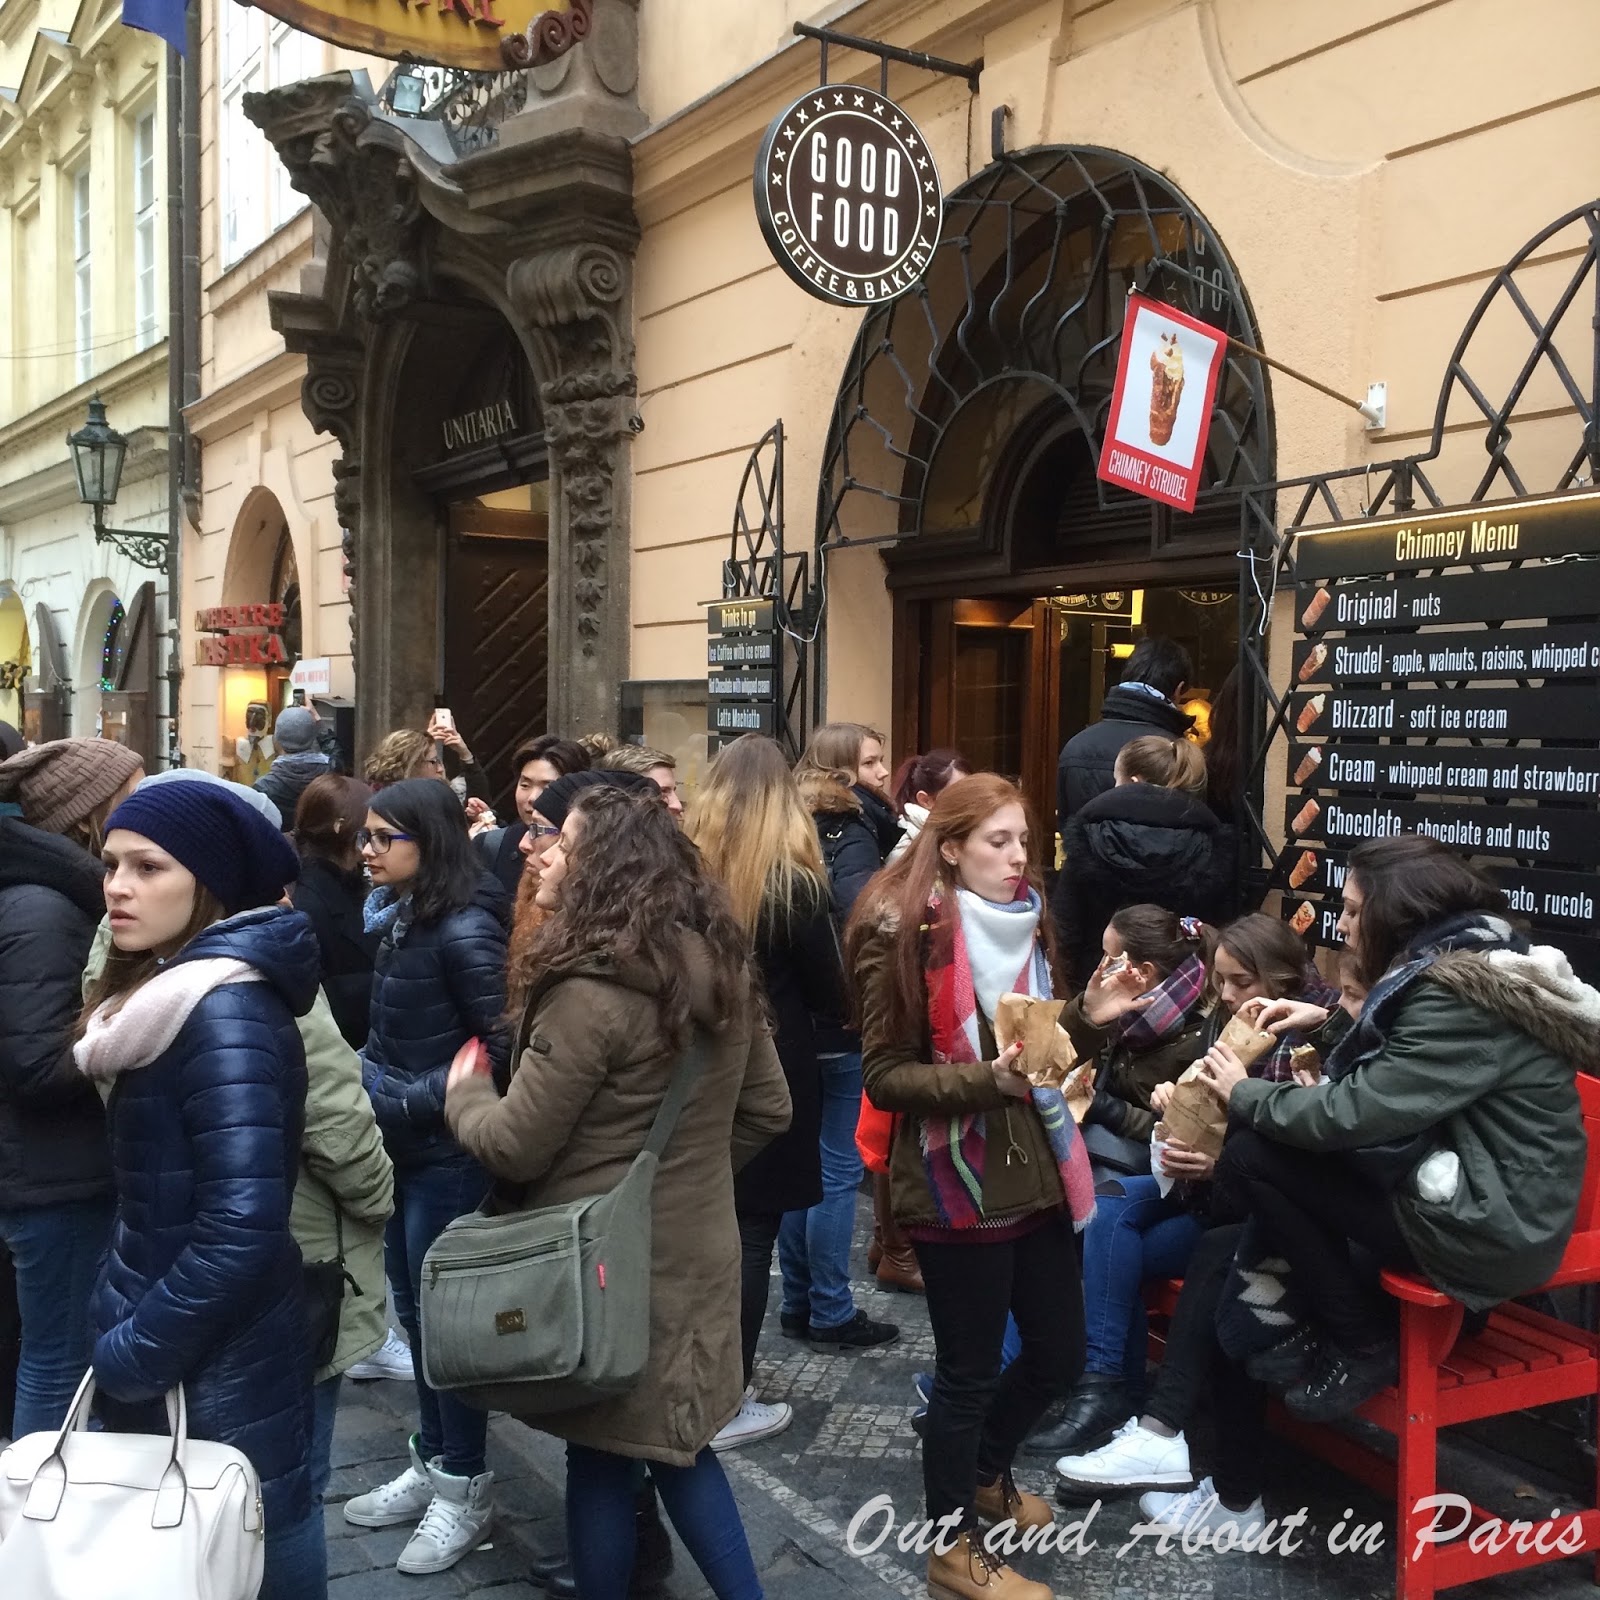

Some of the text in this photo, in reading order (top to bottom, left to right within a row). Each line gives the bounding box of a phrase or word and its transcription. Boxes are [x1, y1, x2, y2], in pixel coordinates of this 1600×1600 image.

[810, 131, 901, 198] GOOD
[810, 191, 899, 257] FOOD
[774, 210, 840, 293] COFFEE
[864, 235, 933, 299] BAKERY
[443, 399, 517, 450] UNITARIA
[1108, 449, 1188, 502] CHIMNEY STRUDEL
[1395, 520, 1519, 561] Chimney Menu
[721, 608, 756, 629] Drinks to go
[1337, 589, 1398, 625] Original
[1412, 592, 1441, 617] nuts
[716, 643, 733, 662] Coffee
[1335, 643, 1383, 675] Strudel
[1392, 648, 1425, 676] apple,
[1428, 646, 1478, 672] walnuts,
[1481, 644, 1527, 671] raisins,
[1531, 641, 1588, 672] whipped
[717, 707, 732, 727] Latte
[1332, 699, 1394, 729] Blizzard
[1410, 704, 1436, 729] soft
[1440, 704, 1461, 729] ice
[1465, 708, 1508, 729] cream
[1329, 752, 1376, 783] Cream
[1388, 760, 1443, 789] whipped
[1446, 766, 1488, 788] cream
[1492, 763, 1519, 790] and
[1326, 805, 1401, 837] Chocolate
[1486, 822, 1513, 848] and
[1517, 824, 1550, 851] nuts
[1544, 891, 1593, 919] rucola
